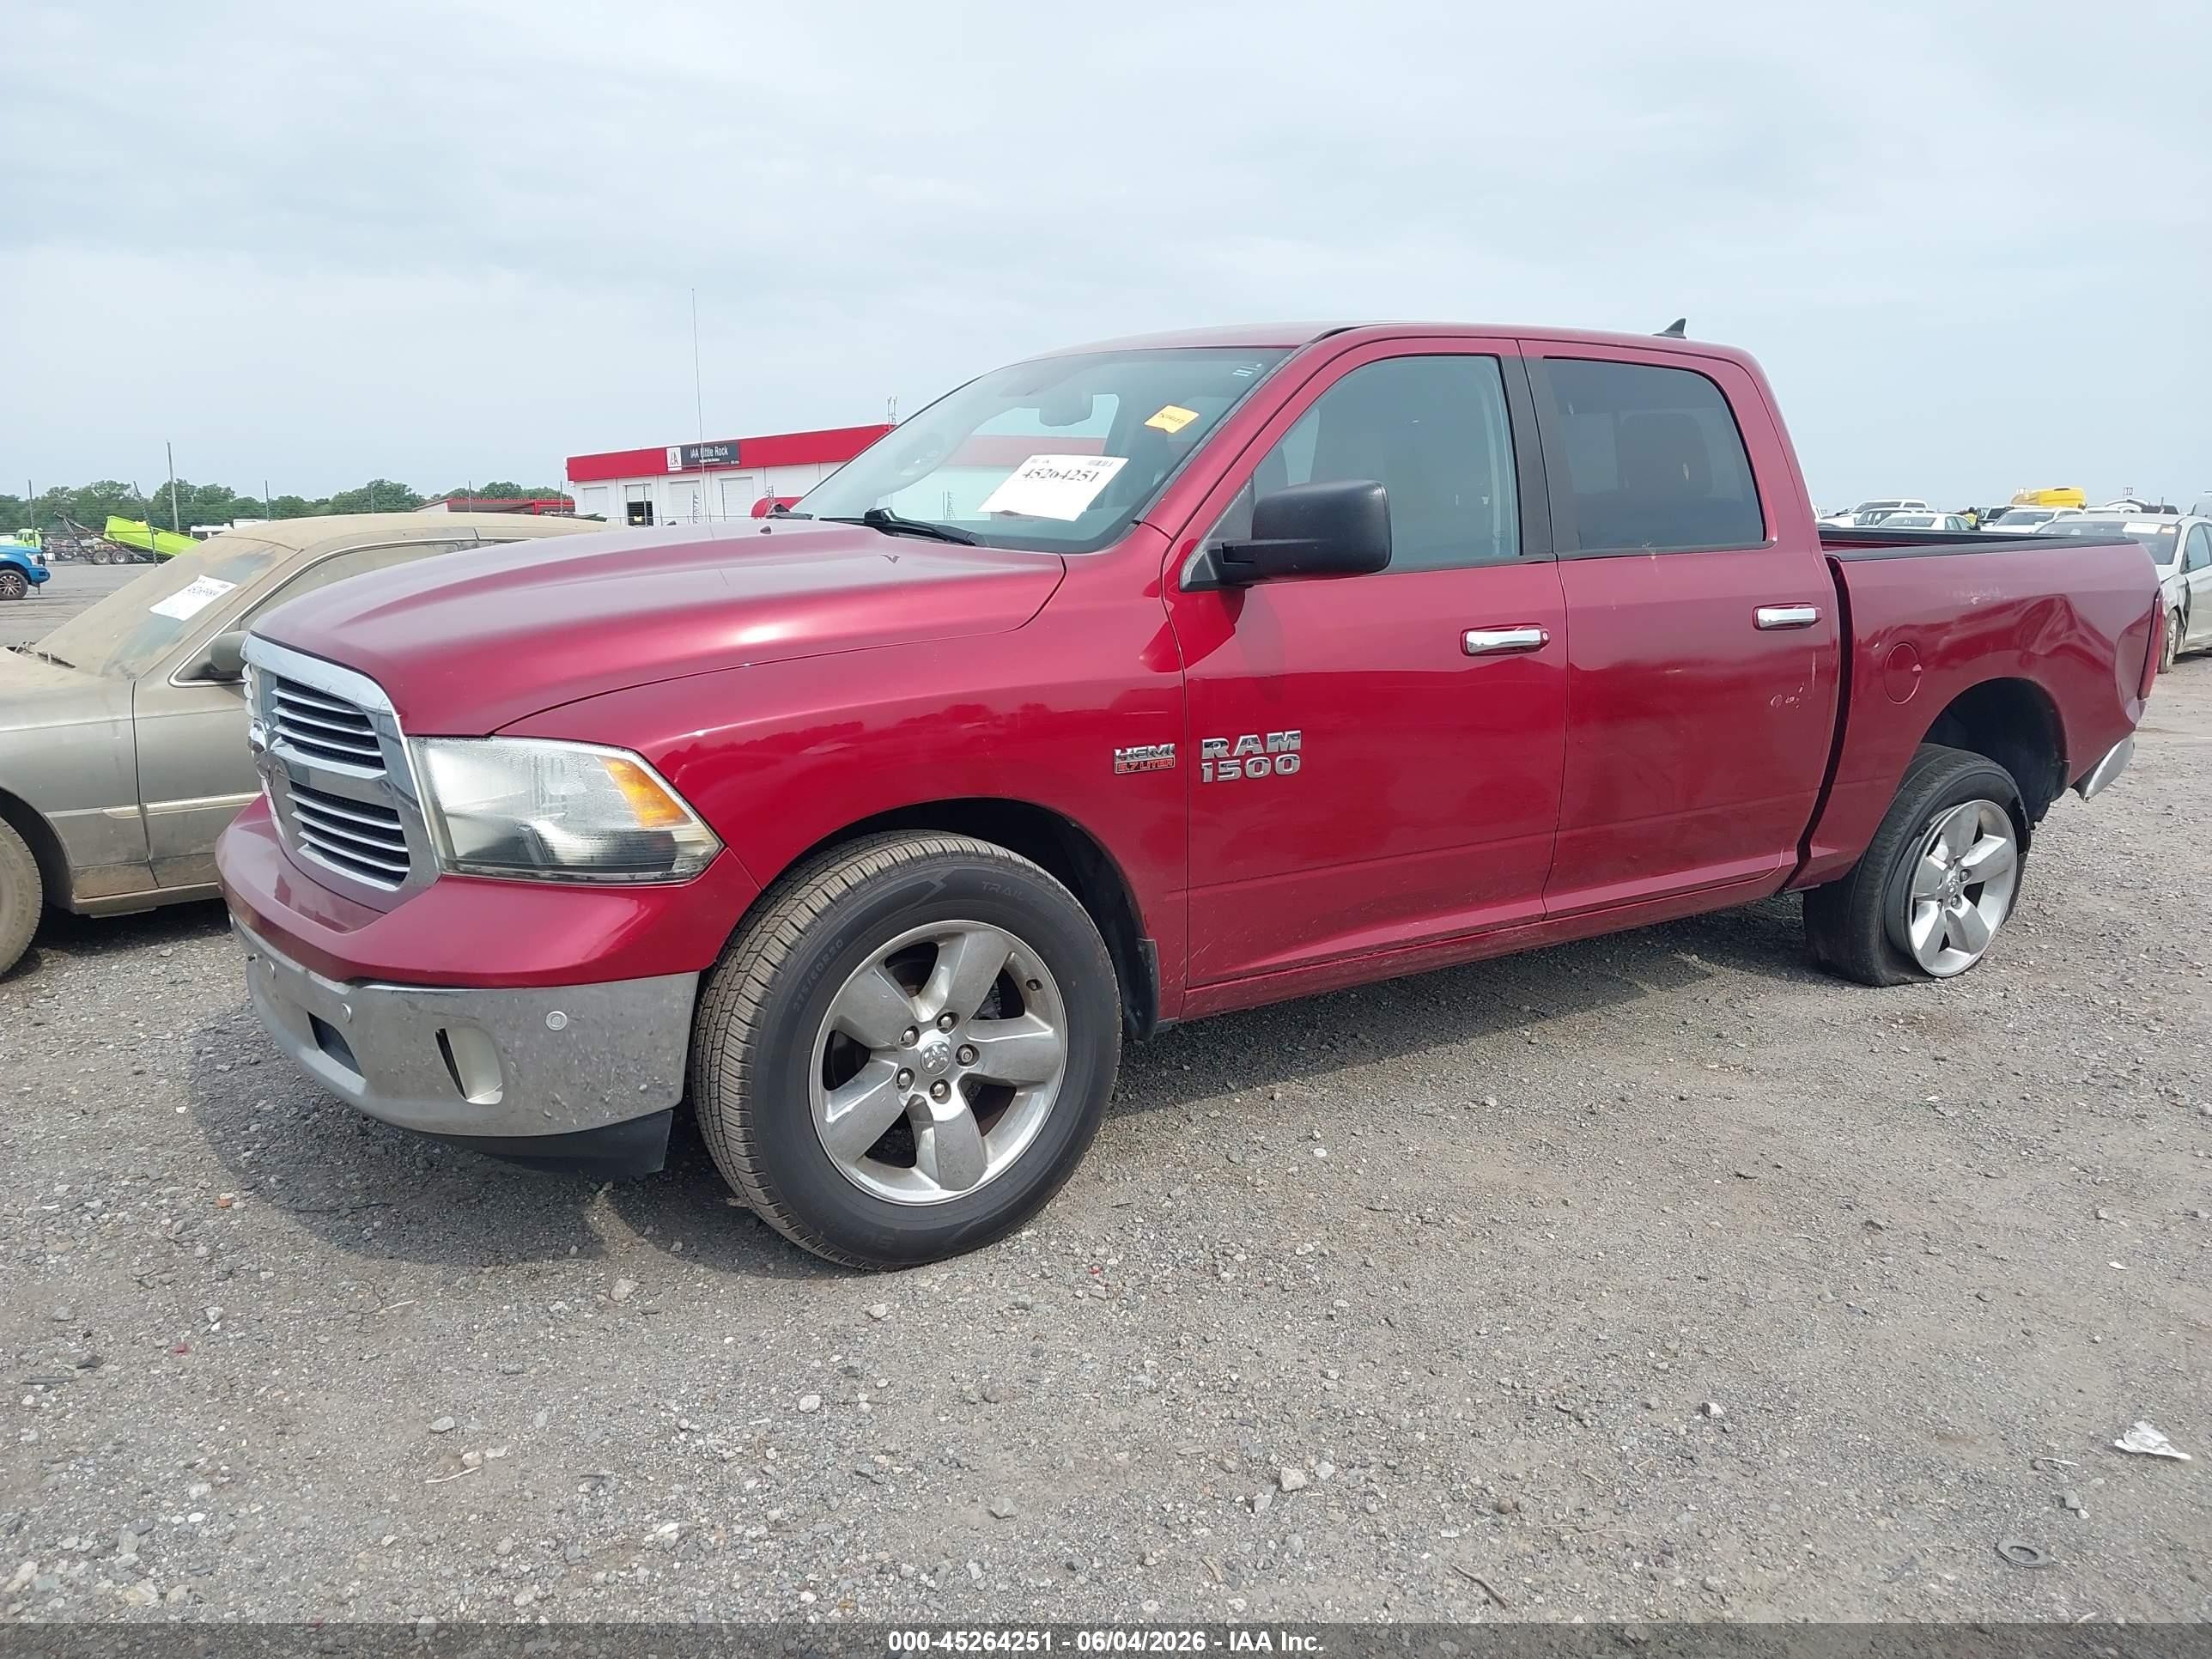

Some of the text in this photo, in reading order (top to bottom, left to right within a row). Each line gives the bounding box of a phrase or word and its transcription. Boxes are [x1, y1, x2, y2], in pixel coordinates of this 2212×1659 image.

[690, 447, 700, 459] IAA
[714, 445, 729, 457] Rock
[1115, 743, 1176, 763] HEMI
[1201, 730, 1302, 760] RAM
[1118, 757, 1174, 773] 5.7 LITER
[1201, 753, 1301, 783] 1500
